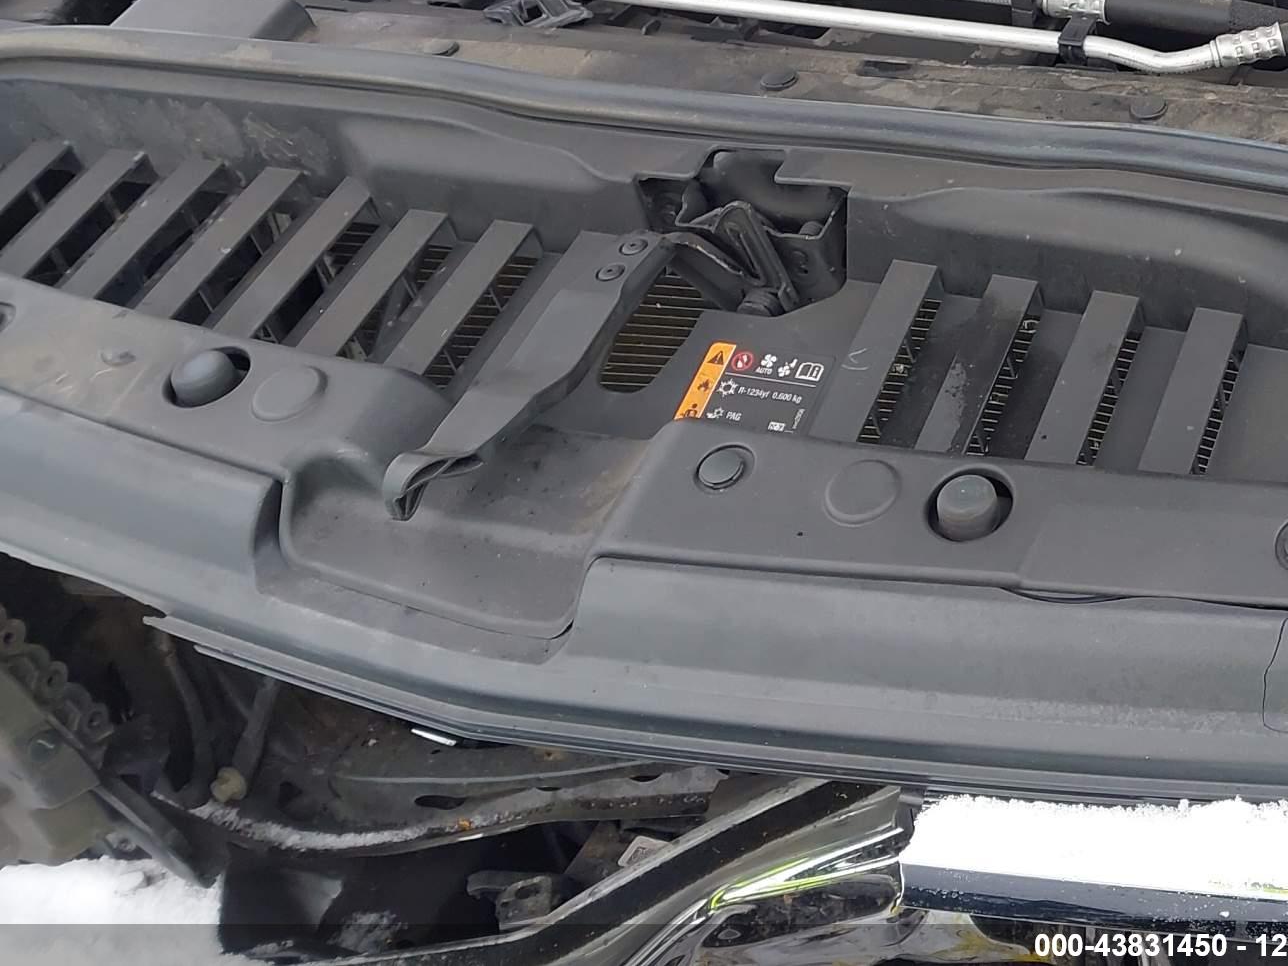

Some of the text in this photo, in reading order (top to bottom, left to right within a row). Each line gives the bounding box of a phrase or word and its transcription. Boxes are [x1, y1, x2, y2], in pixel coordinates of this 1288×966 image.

[755, 366, 773, 375] AUTO
[738, 387, 771, 399] R-1234yf
[792, 394, 802, 404] kg
[726, 411, 742, 421] PAG
